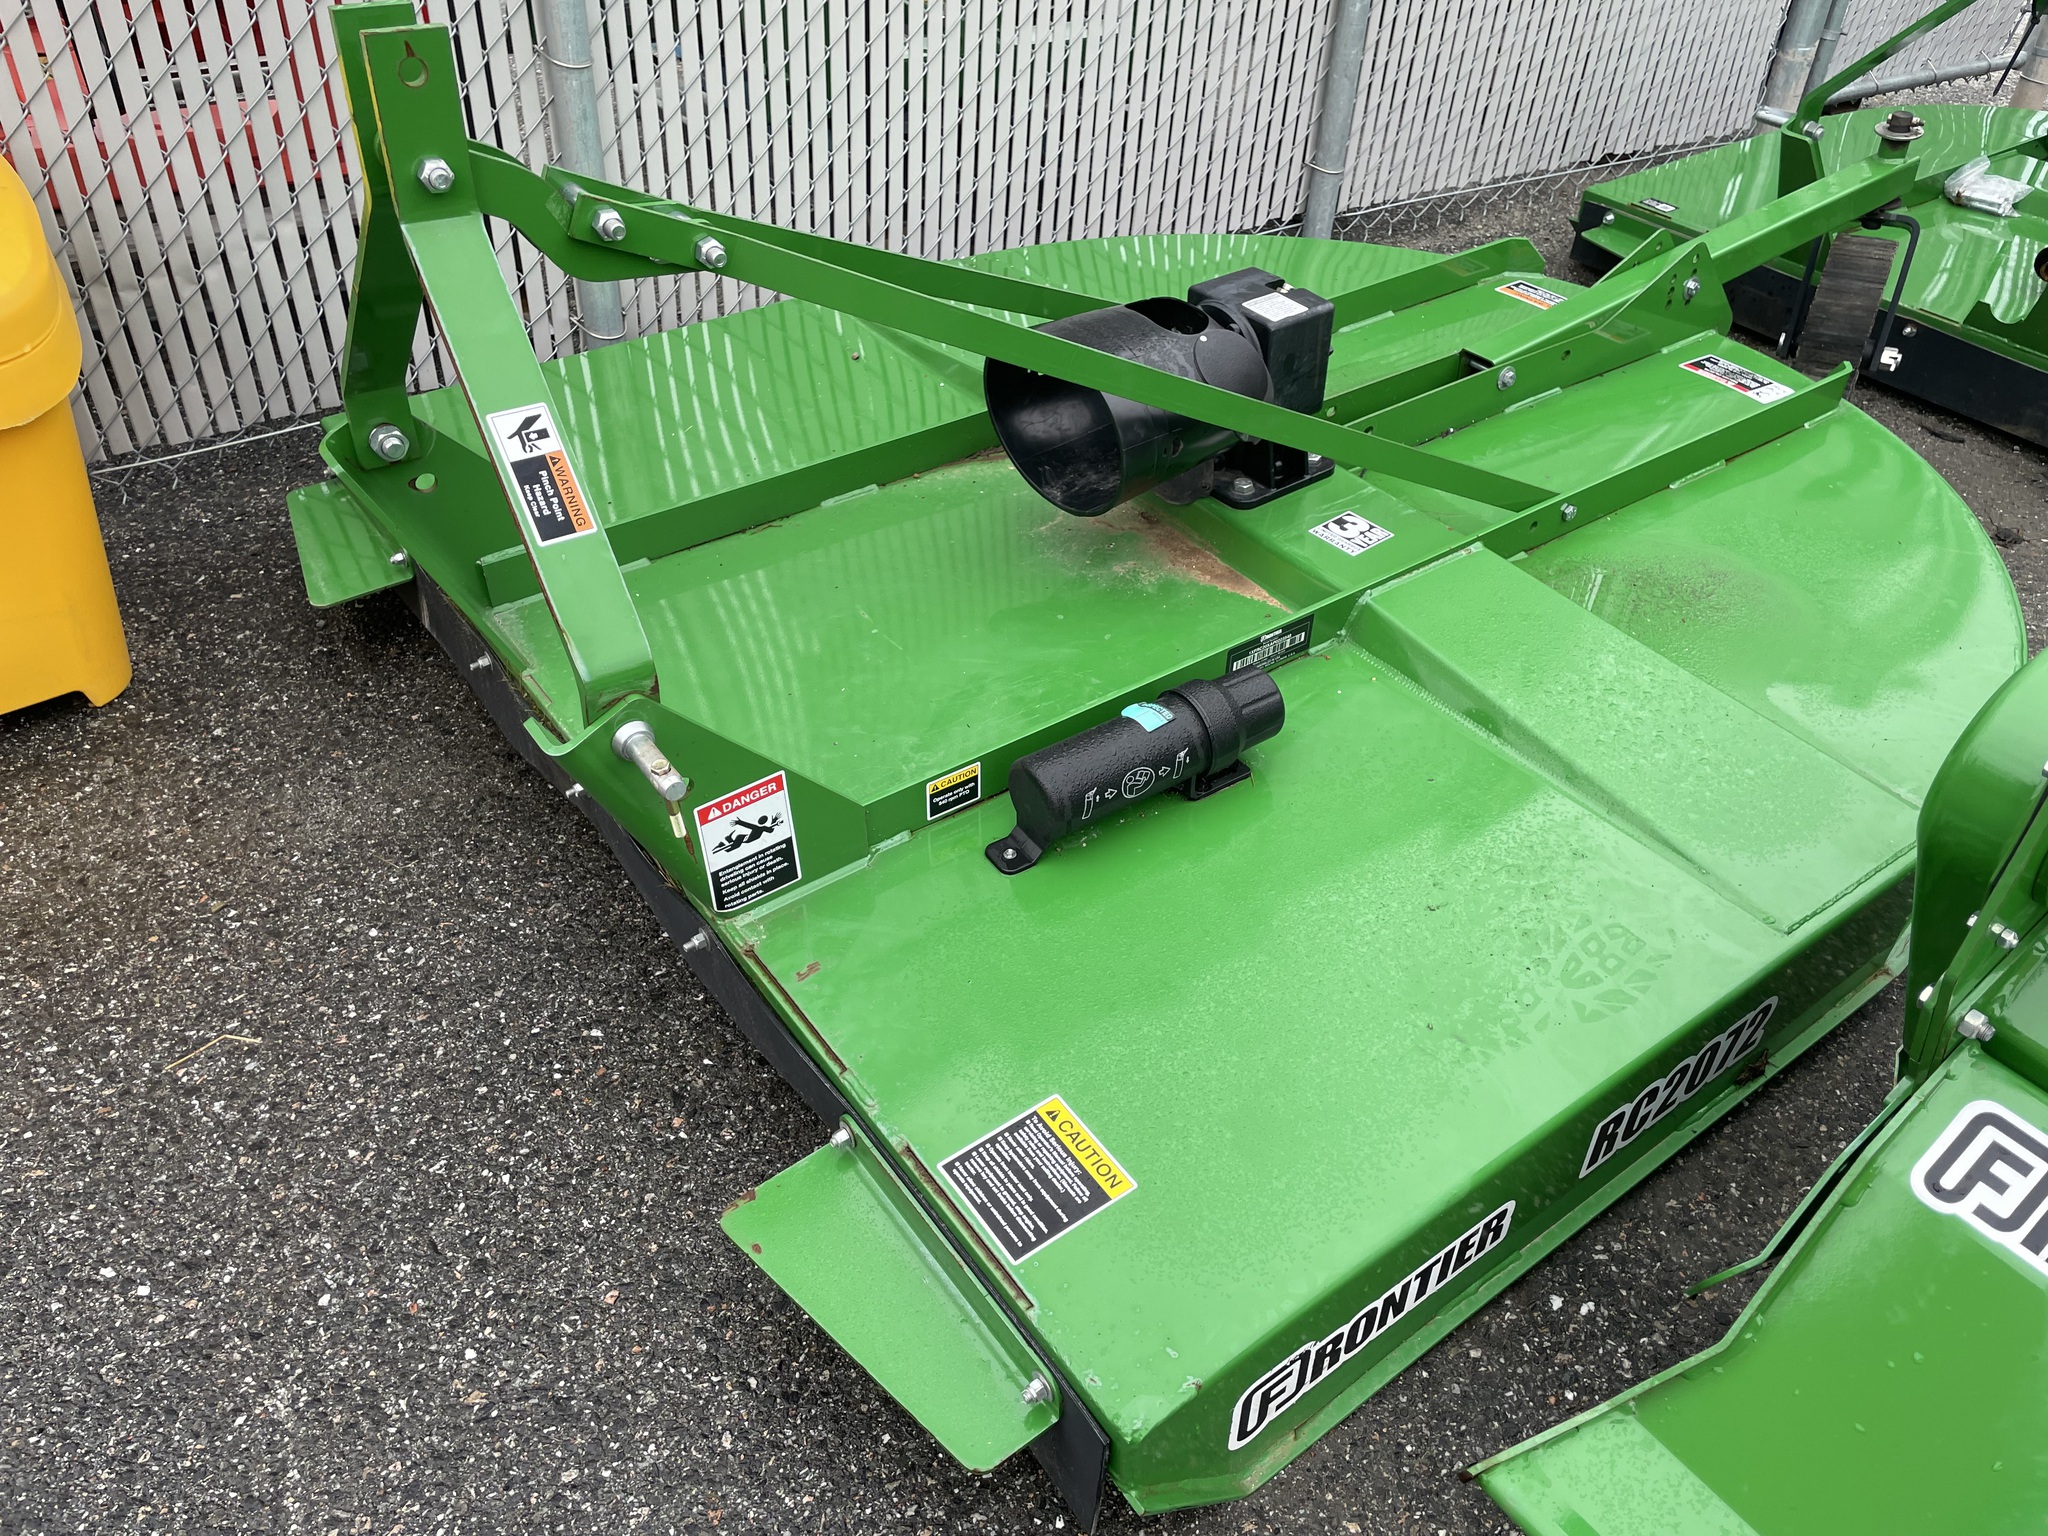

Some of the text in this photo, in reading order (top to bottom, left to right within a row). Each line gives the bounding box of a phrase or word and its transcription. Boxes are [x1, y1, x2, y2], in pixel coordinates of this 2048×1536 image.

[533, 484, 551, 516] Hazard
[539, 470, 565, 521] Pinch Point
[555, 466, 586, 526] WARNING
[1328, 516, 1370, 539] 3
[722, 782, 777, 813] DANGER
[941, 768, 976, 788] CAUTION
[722, 886, 737, 894] Keep
[724, 892, 740, 901] Avoid
[763, 876, 774, 884] with
[1585, 999, 1775, 1174] RC2072
[1030, 1115, 1082, 1175] To Avoid Serious Injury:
[1058, 1120, 1123, 1190] CAUTION
[1236, 1204, 1511, 1443] FRONTIER
